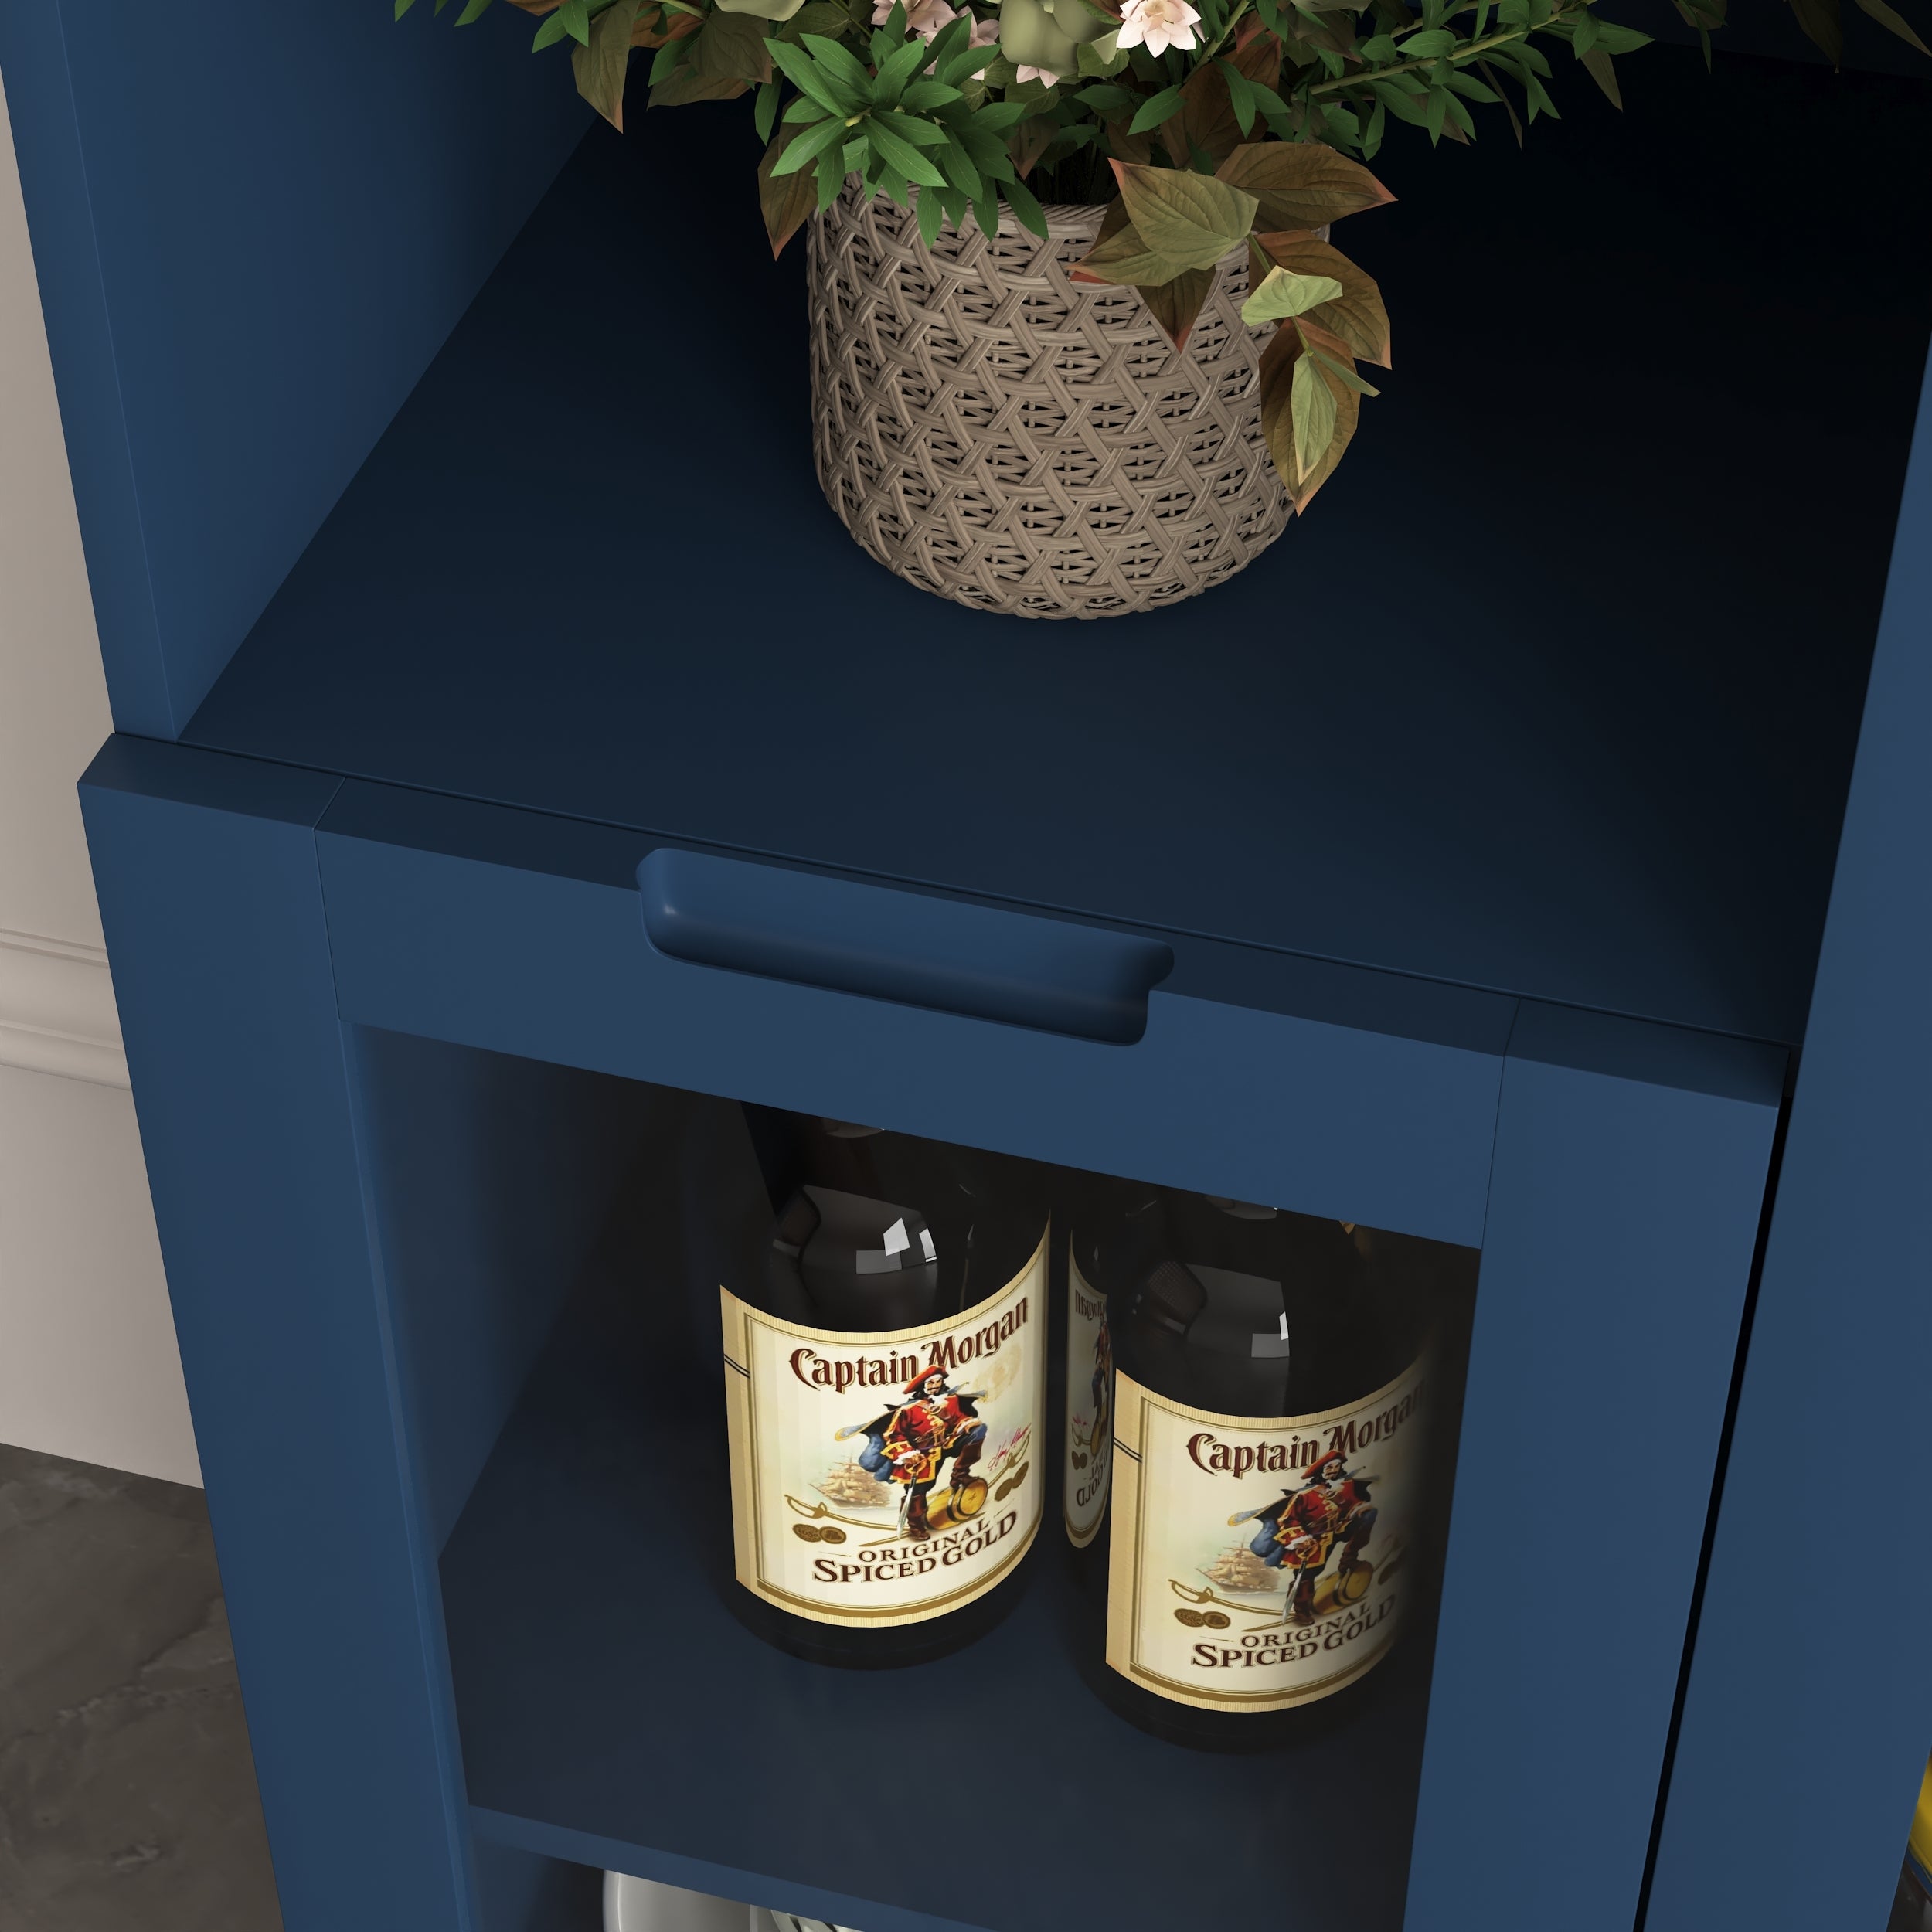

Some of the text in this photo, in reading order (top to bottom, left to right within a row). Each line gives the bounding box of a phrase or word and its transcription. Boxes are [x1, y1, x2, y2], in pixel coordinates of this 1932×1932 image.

[788, 1297, 1029, 1394] Captain Morgan
[1186, 1432, 1320, 1479] Captain
[859, 1517, 990, 1563] ORIGINAL
[942, 1510, 1017, 1566] GOLD
[1241, 1604, 1371, 1648] ORIGINAL
